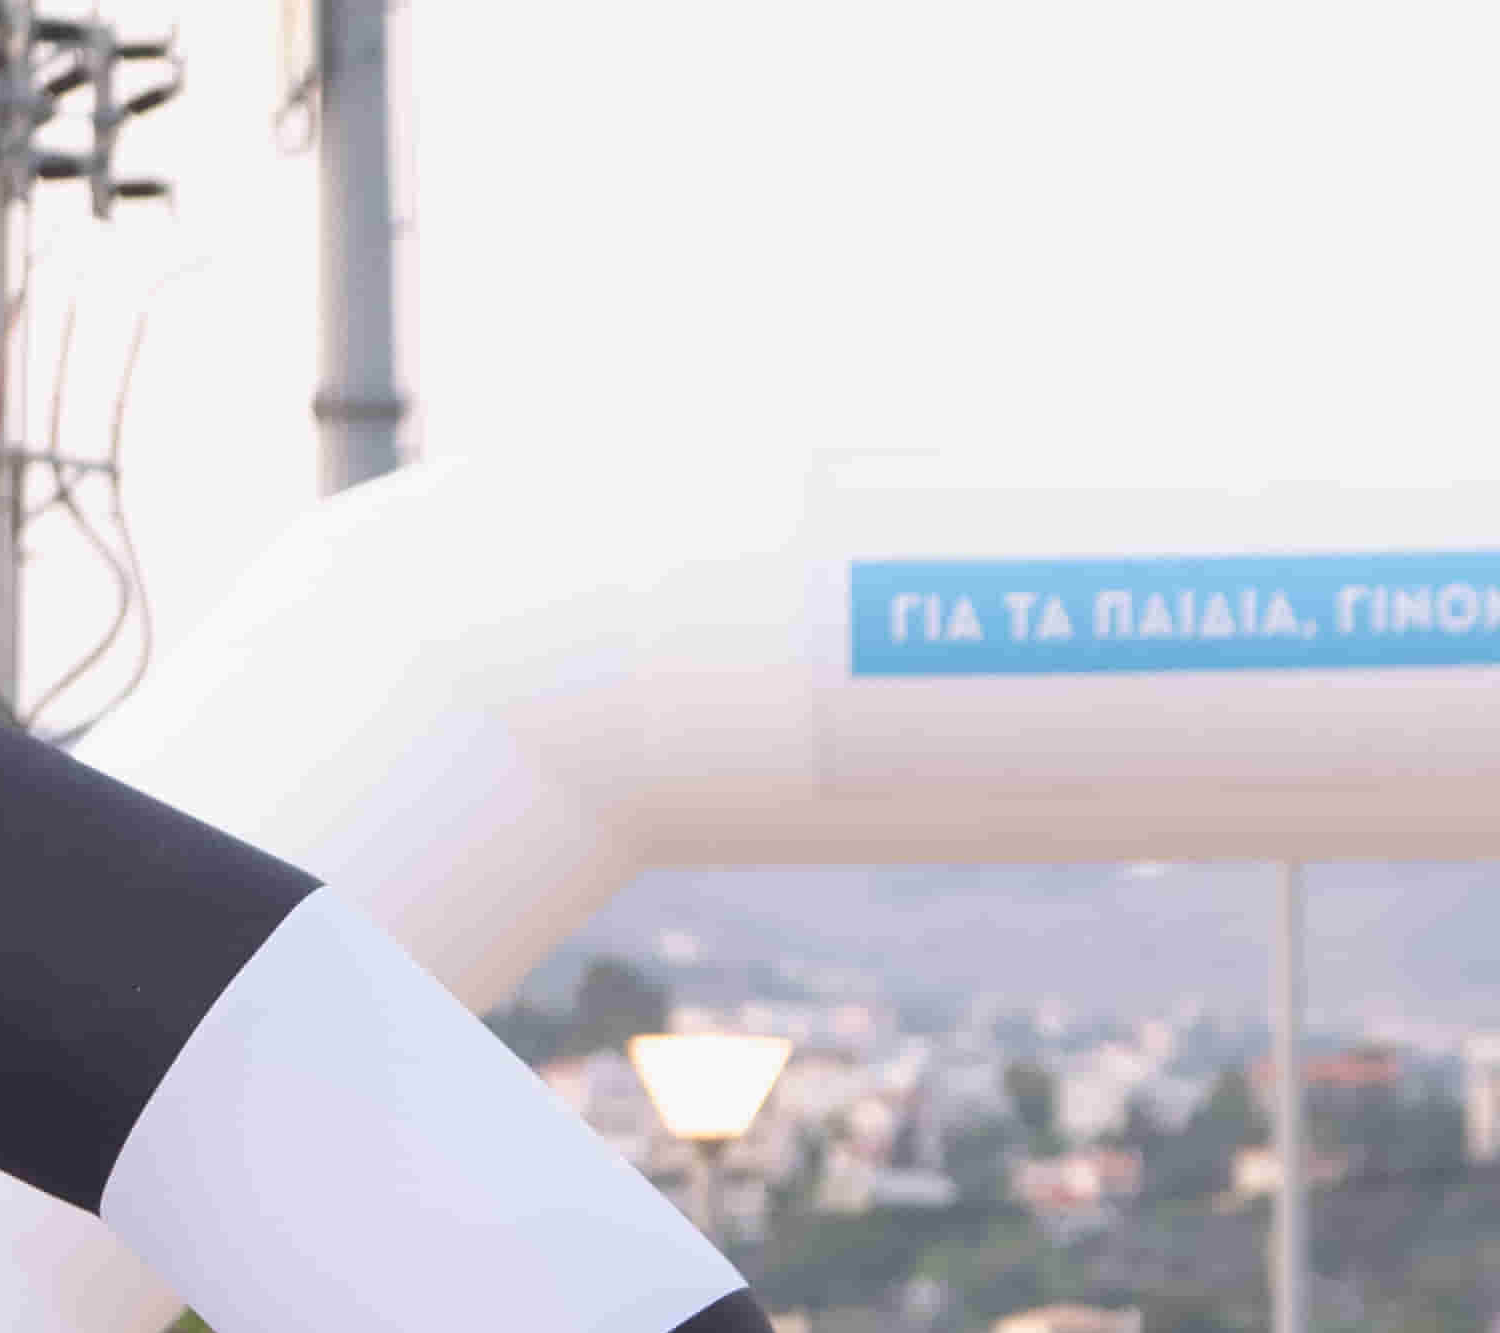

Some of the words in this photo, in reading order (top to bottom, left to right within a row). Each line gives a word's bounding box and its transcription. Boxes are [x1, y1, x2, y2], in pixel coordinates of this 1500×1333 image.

[889, 591, 984, 641] ΓΙΑ
[1003, 591, 1075, 641] ΤΑ
[1092, 586, 1319, 641] ΠΑΙΔΙΑ,
